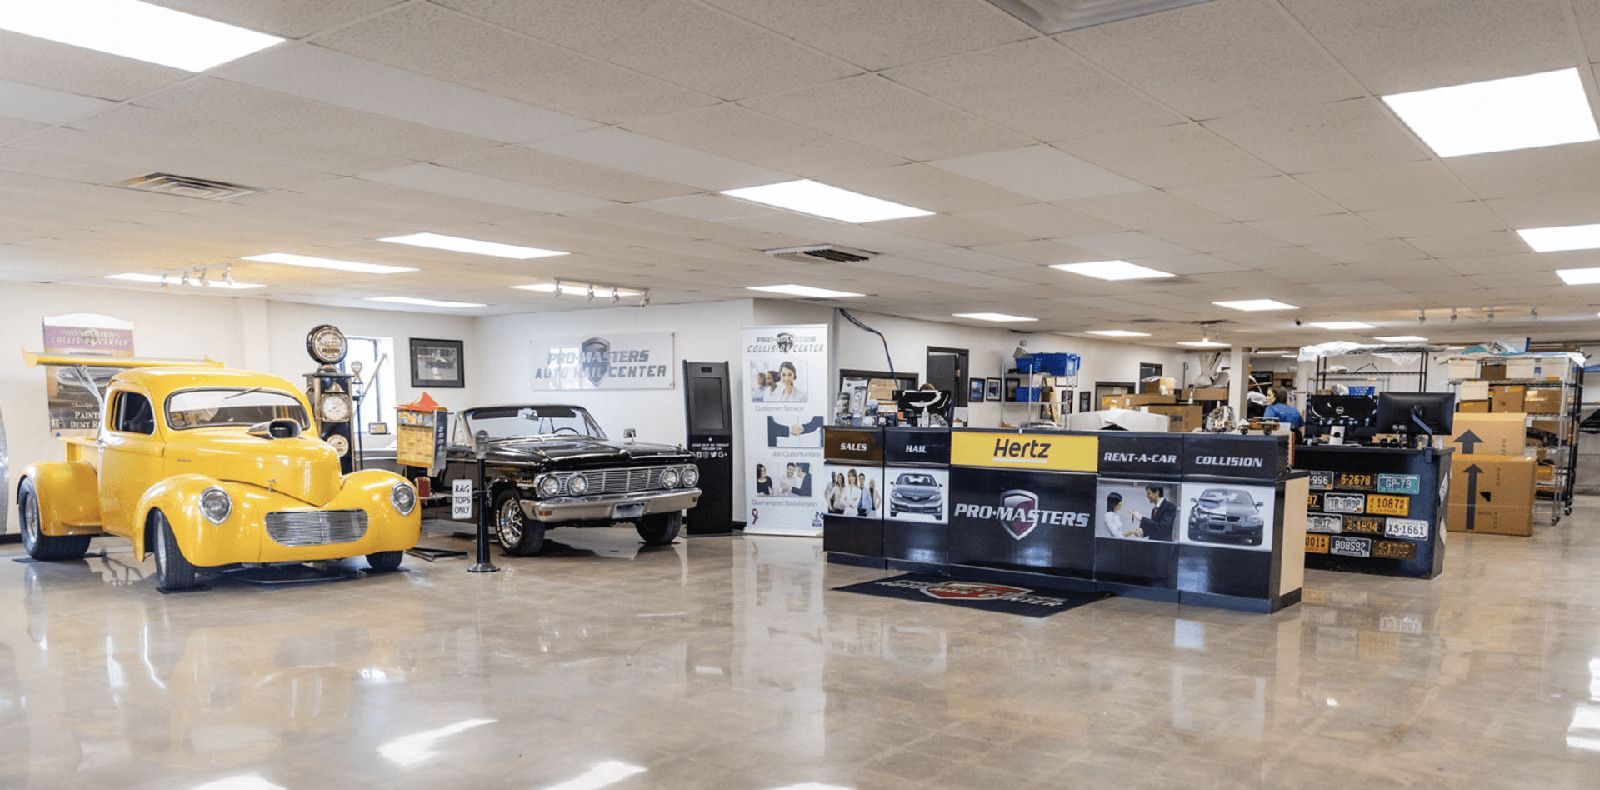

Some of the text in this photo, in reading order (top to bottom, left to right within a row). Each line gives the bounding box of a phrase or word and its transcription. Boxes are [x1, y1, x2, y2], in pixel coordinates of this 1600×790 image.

[747, 344, 824, 353] COLLISION CENTER
[546, 350, 650, 365] PRO-MASTERS
[608, 365, 667, 378] CENTER
[840, 442, 927, 454] SALES HAIL
[993, 438, 1052, 459] Hertz
[1103, 451, 1178, 465] RENT-A-CAR
[1195, 455, 1264, 468] COLLISION
[455, 484, 470, 493] RAG
[455, 496, 471, 504] TOPS
[455, 506, 470, 514] ONLY
[953, 503, 1091, 528] PRO-MASTERS
